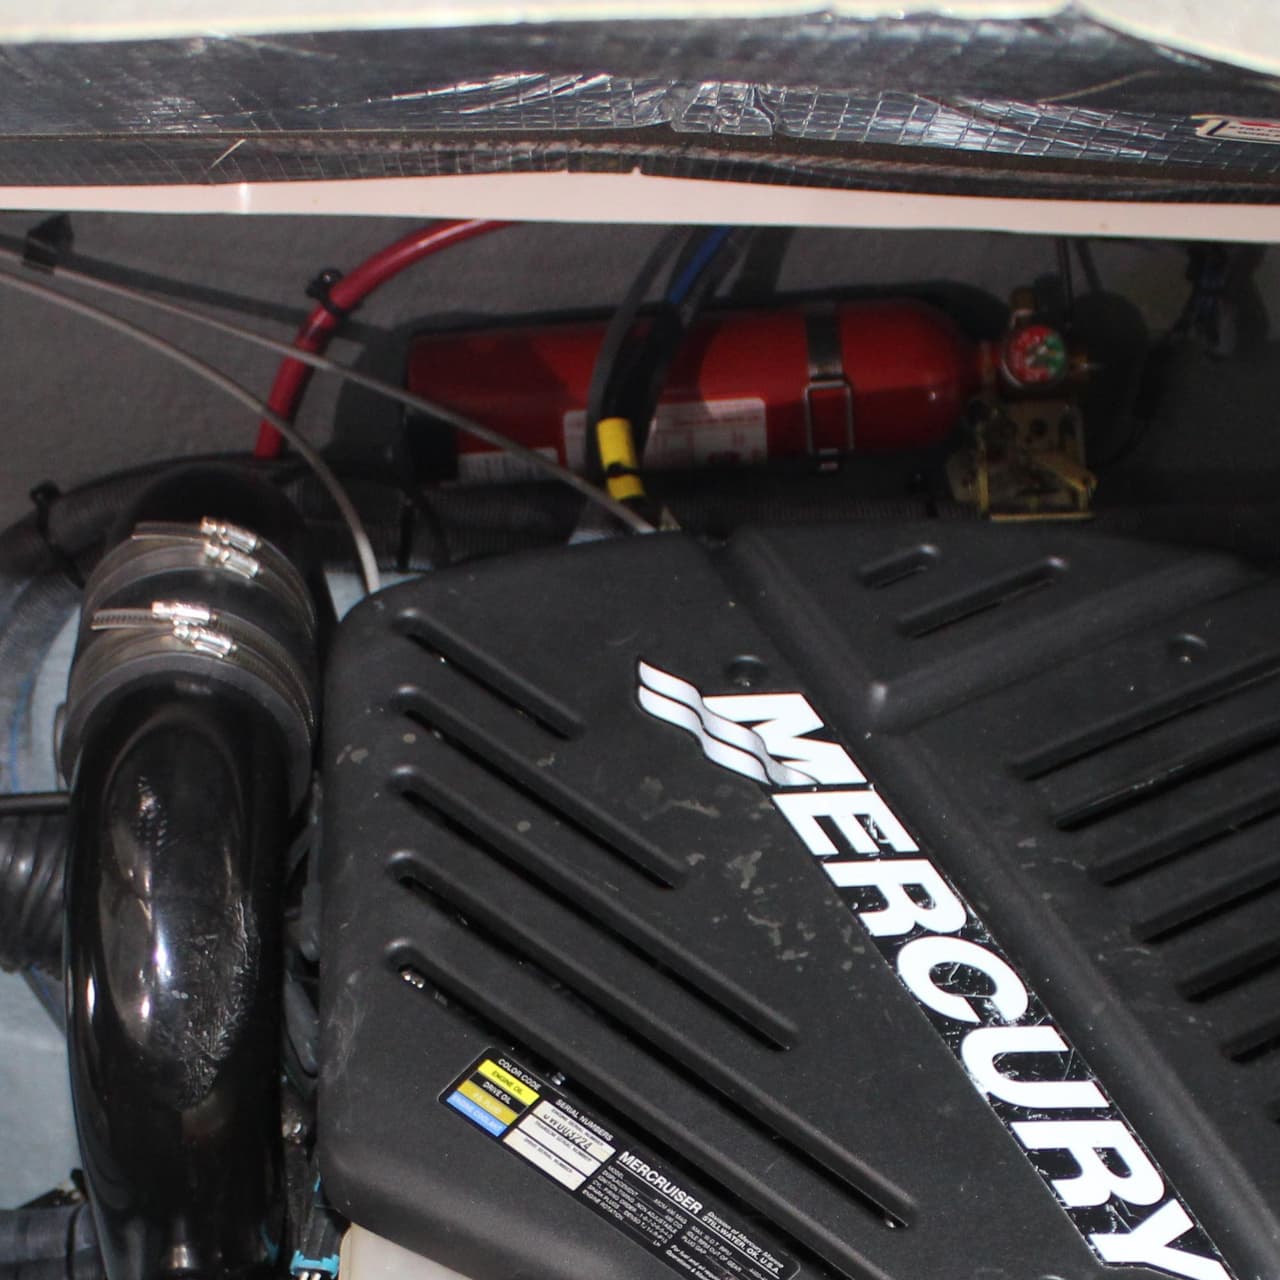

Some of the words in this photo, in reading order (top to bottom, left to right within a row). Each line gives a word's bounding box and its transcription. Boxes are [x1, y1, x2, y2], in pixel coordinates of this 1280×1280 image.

[490, 1070, 514, 1087] ENGINE
[512, 1084, 524, 1094] OIL
[497, 1058, 523, 1077] COLOR
[519, 1074, 541, 1090] CODE
[481, 1080, 503, 1097] DRIVE
[498, 1093, 513, 1104] OIL
[554, 1098, 580, 1118] SERIAL
[577, 1114, 614, 1141] NUMBERS
[616, 1150, 705, 1215] MERCRUISER
[700, 1214, 749, 1250] STILLWATER,
